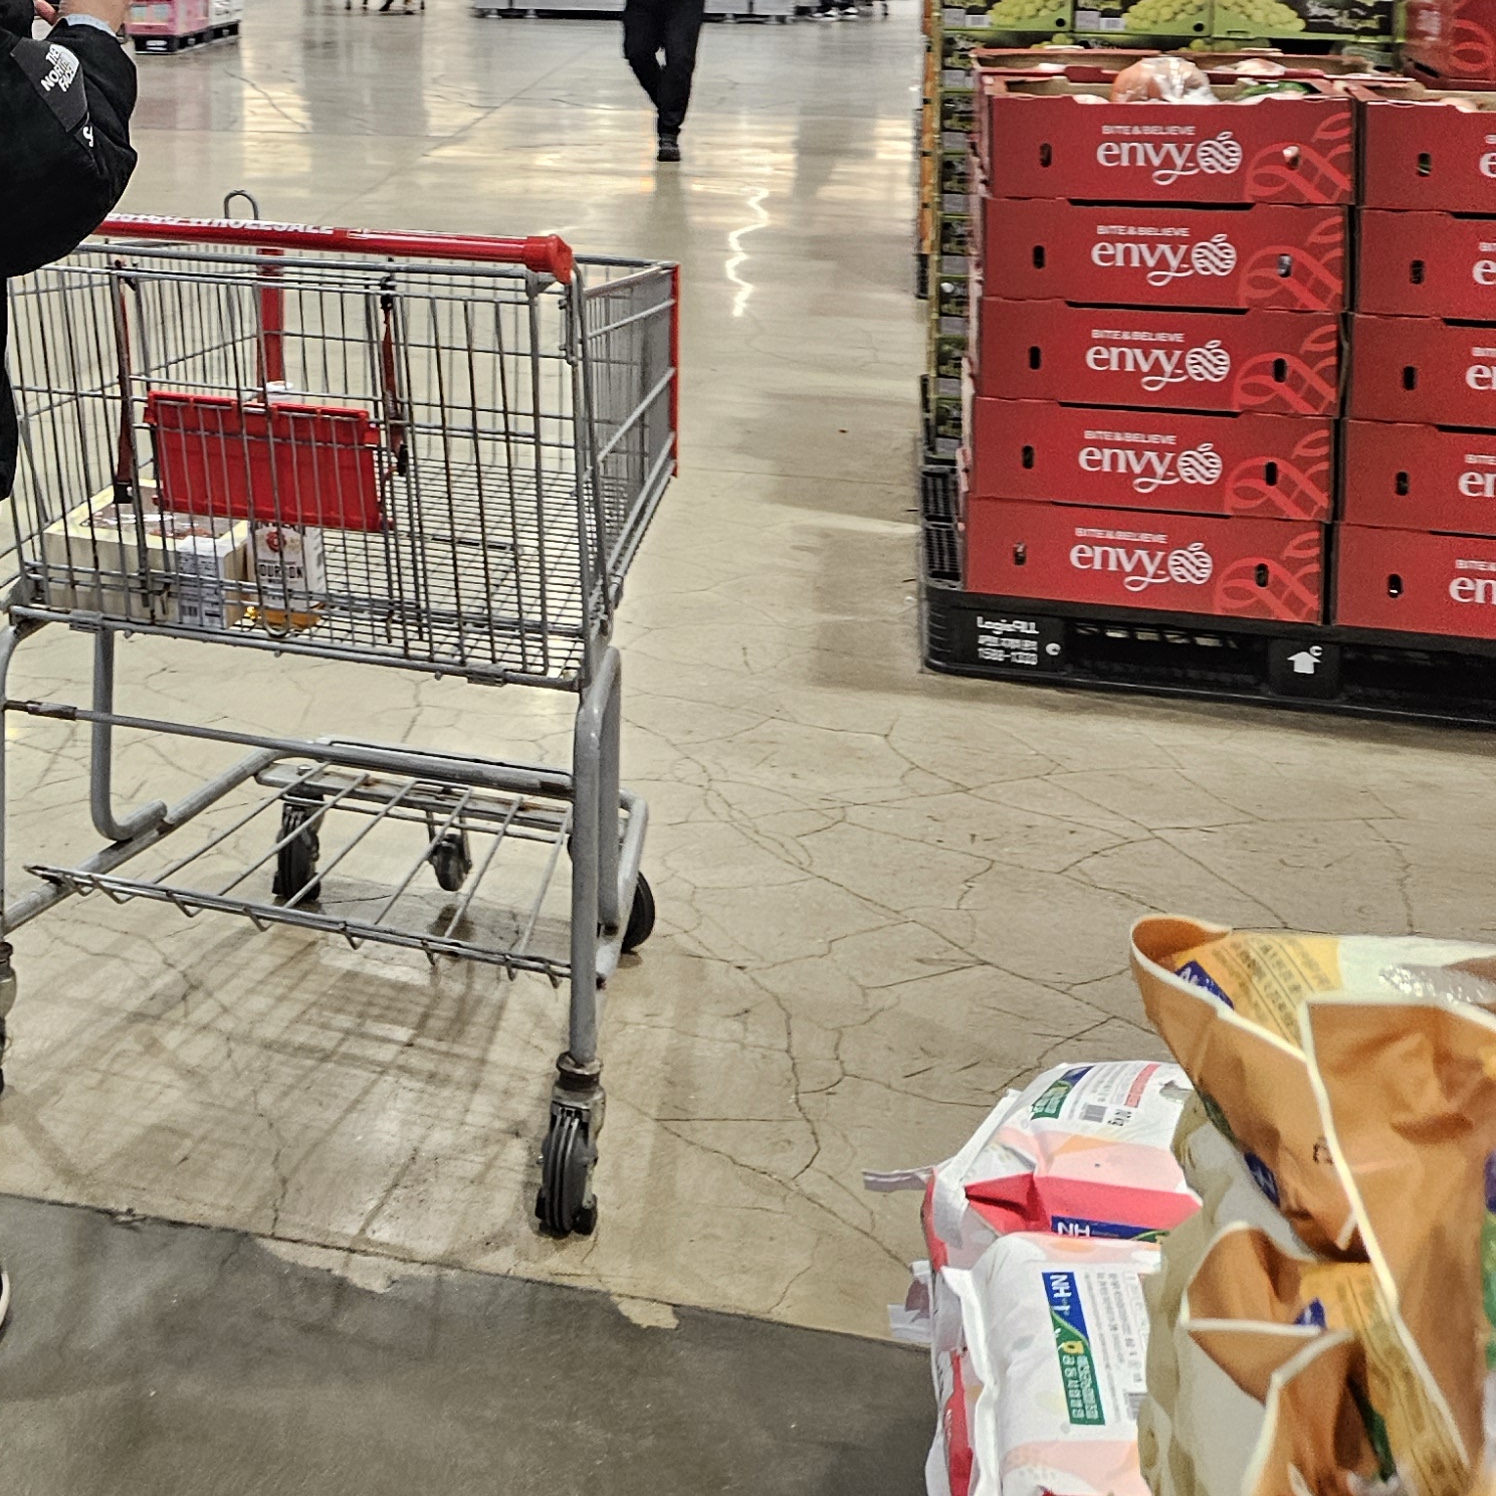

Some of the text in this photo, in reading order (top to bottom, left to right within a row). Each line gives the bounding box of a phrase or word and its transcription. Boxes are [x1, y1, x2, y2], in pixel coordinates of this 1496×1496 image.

[1096, 142, 1202, 186] envy
[1091, 241, 1196, 287] envy
[1085, 345, 1190, 391] envy
[1078, 446, 1181, 494] envy
[1458, 470, 1496, 498] en
[251, 563, 304, 579] OURON
[1069, 544, 1172, 592] envy
[1449, 575, 1496, 605] en
[1057, 1221, 1091, 1237] NH
[1049, 1274, 1072, 1298] NH
